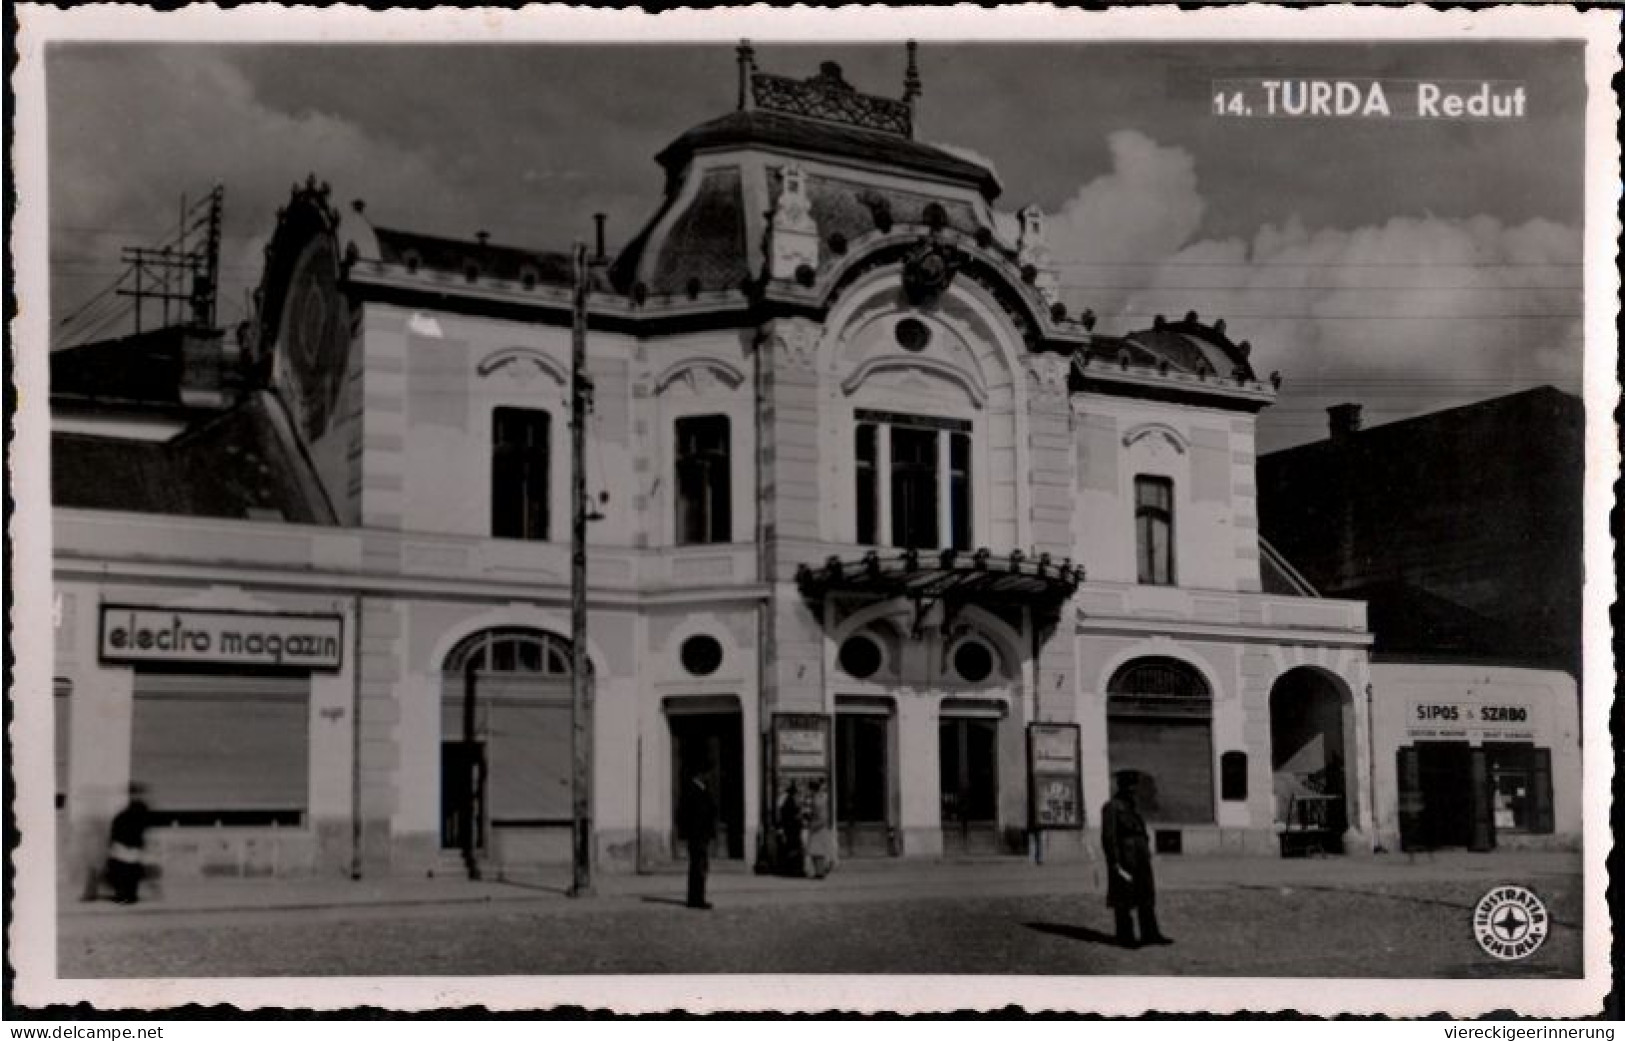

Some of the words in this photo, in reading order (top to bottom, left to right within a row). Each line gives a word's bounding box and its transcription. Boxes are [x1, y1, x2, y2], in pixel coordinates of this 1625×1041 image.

[109, 612, 211, 652] electro
[219, 631, 339, 665] magazin
[1416, 704, 1459, 720] SIPOS
[1481, 706, 1527, 722] SZABO
